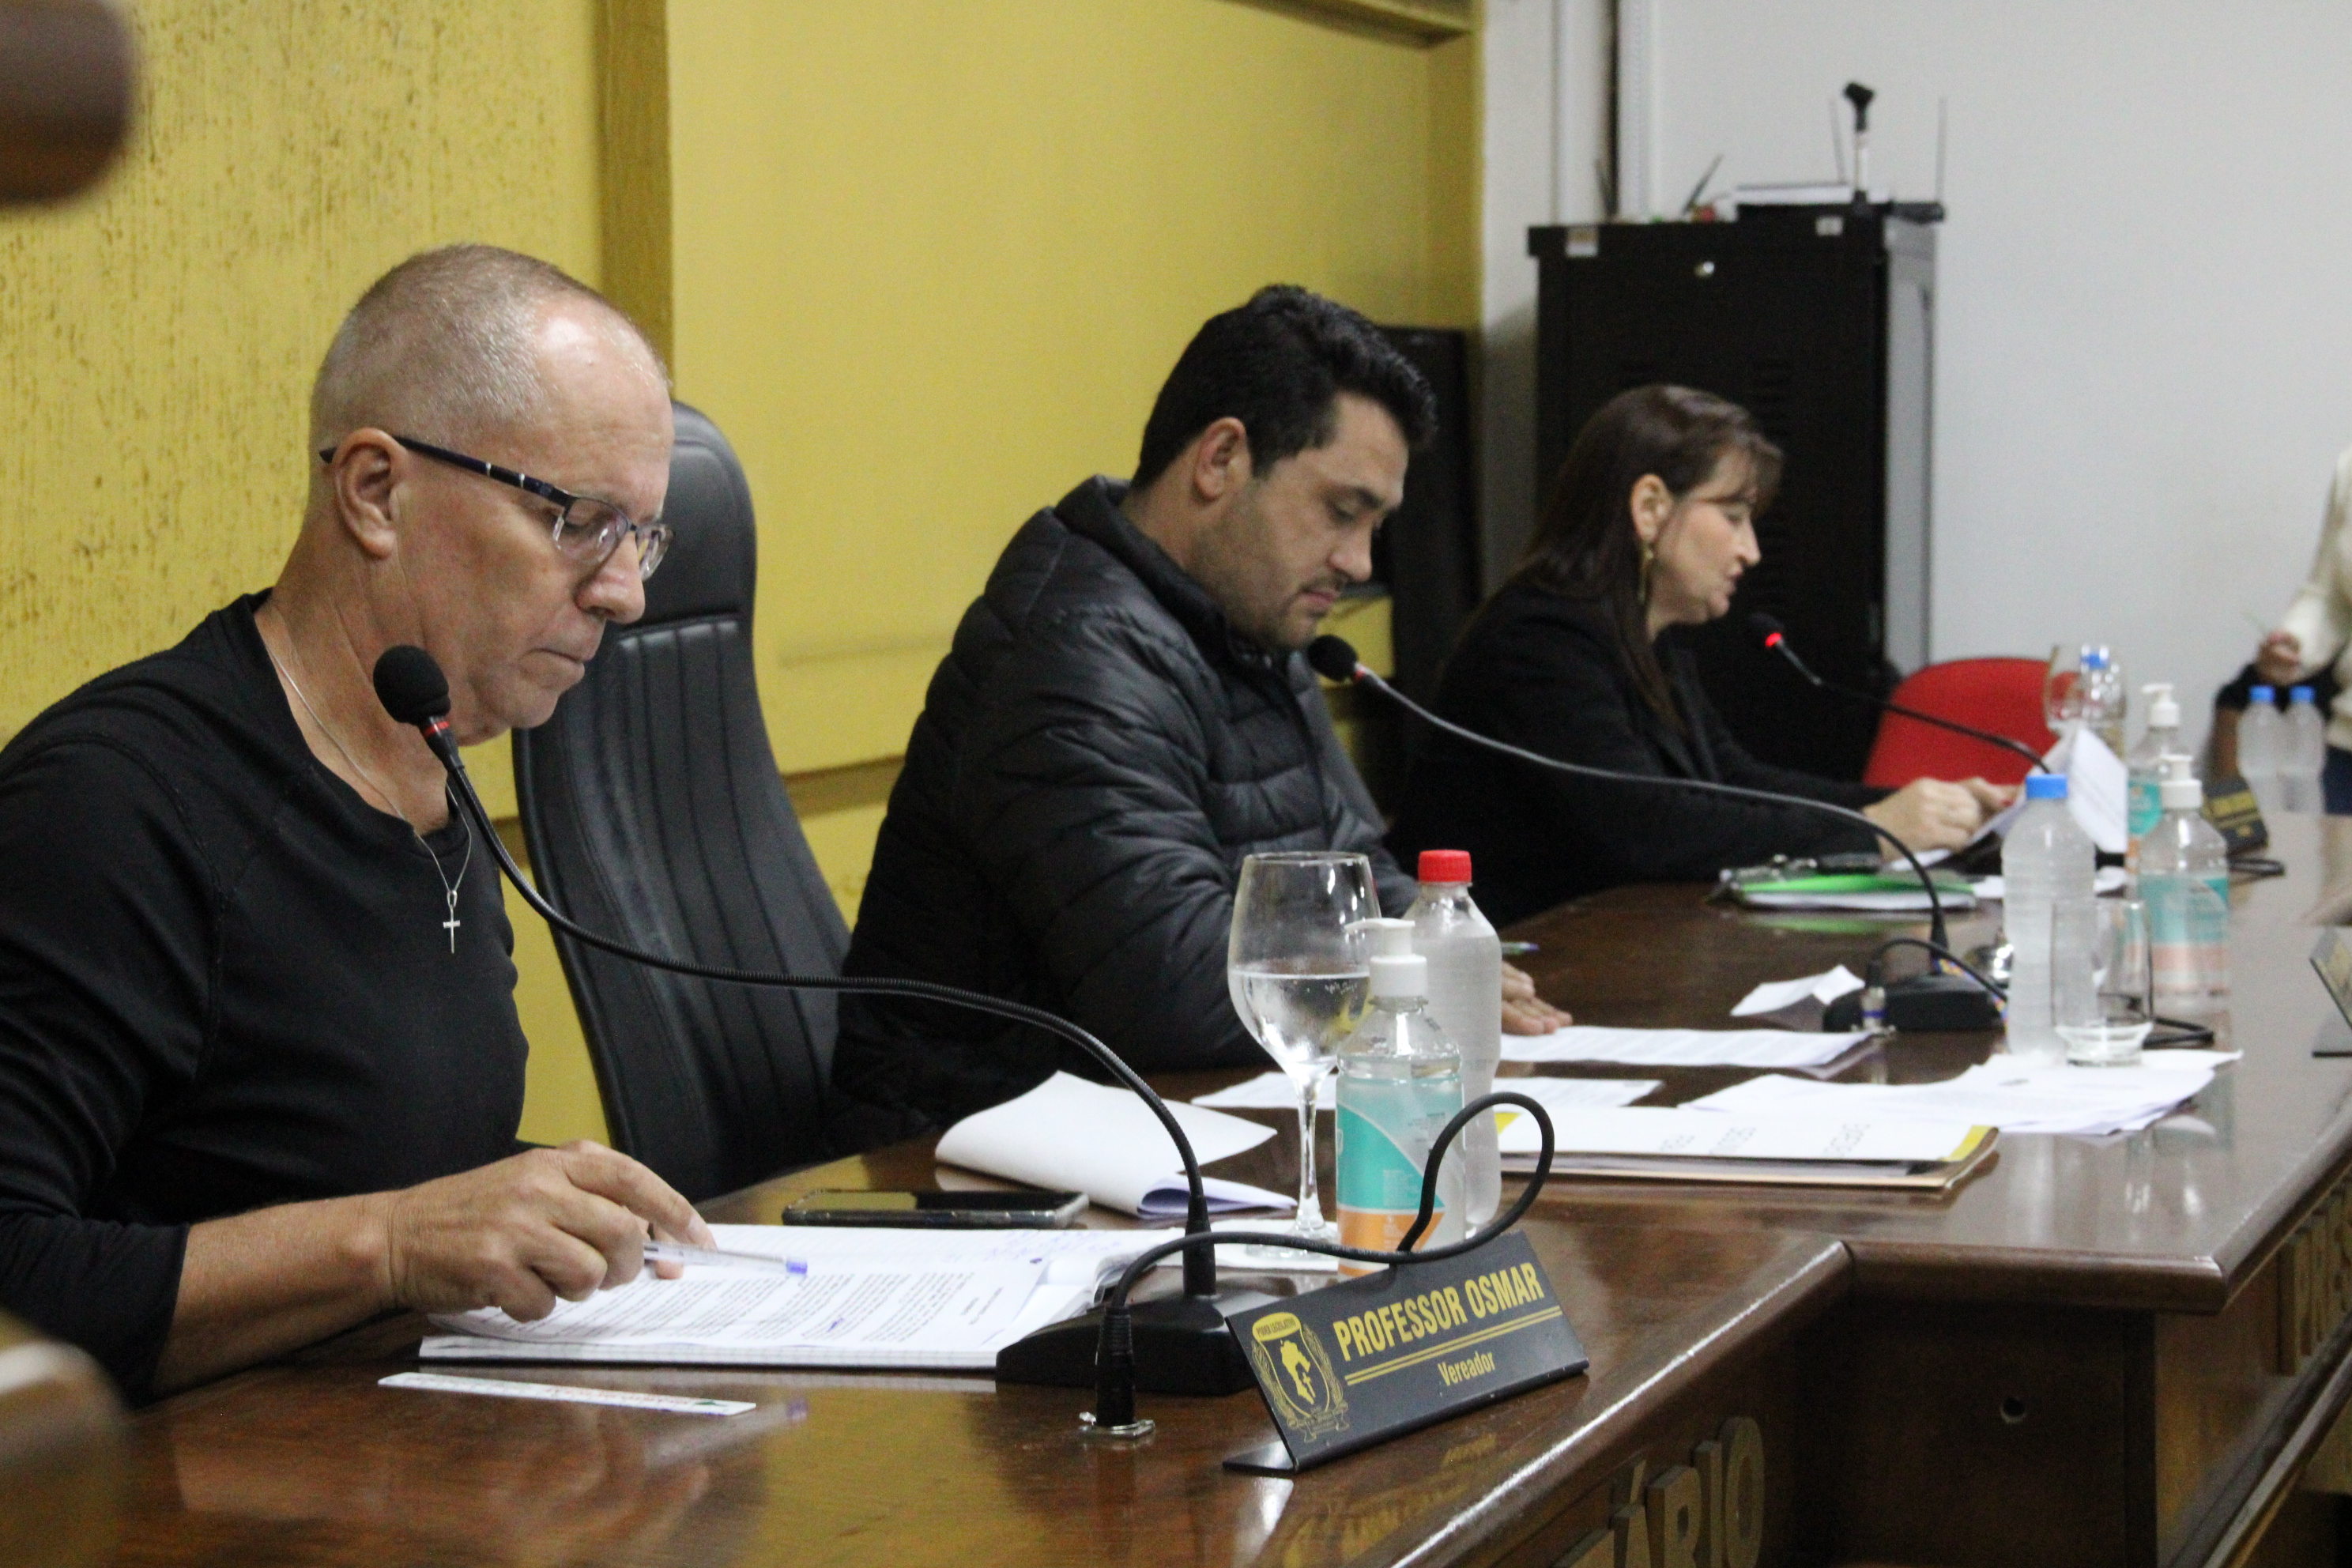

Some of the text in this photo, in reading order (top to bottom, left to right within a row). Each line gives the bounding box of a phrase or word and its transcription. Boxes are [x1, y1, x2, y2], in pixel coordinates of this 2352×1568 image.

[1332, 1262, 1545, 1361] PROFESSOR OSMAR
[1438, 1351, 1496, 1387] Vereador
